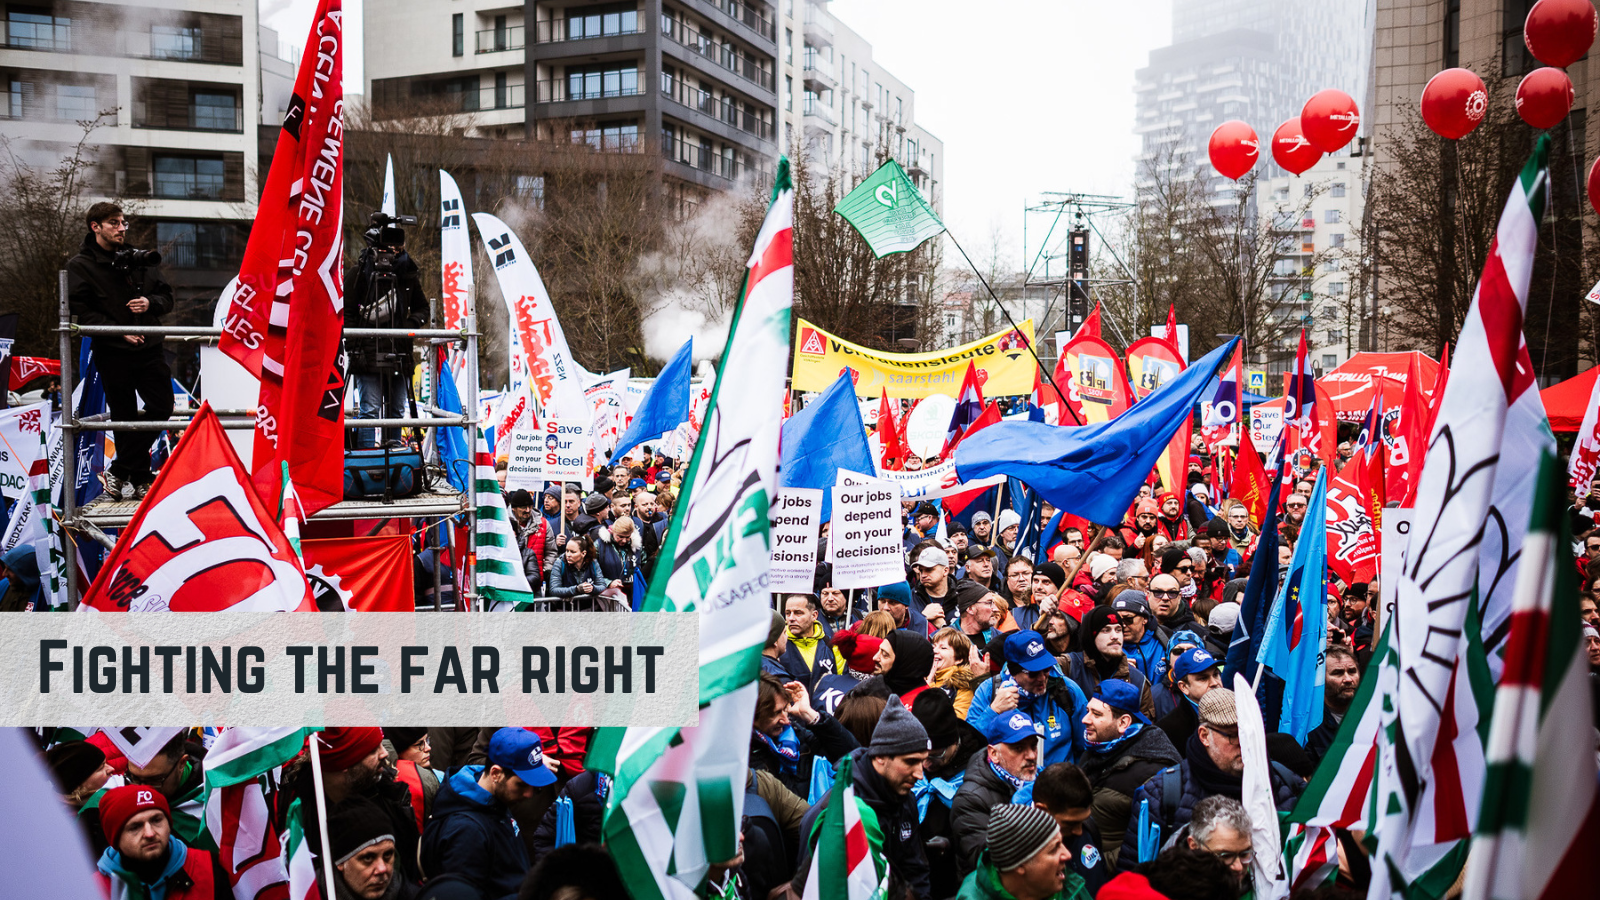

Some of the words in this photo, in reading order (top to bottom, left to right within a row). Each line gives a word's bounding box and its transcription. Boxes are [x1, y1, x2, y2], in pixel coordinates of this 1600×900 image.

[831, 339, 995, 368] Vertrauensleute
[889, 370, 955, 384] saarstahl
[1253, 410, 1279, 419] Save
[546, 421, 583, 435] Save
[1253, 419, 1272, 433] Our
[545, 434, 573, 452] Our
[1254, 432, 1279, 441] Stee
[516, 445, 542, 453] depend
[525, 456, 541, 464] your
[546, 453, 583, 466] Steel
[894, 468, 946, 480] DUMPING
[782, 495, 812, 510] jobs
[841, 493, 864, 504] Our
[866, 491, 892, 505] jobs
[775, 515, 810, 529] pend
[844, 508, 892, 524] depend
[776, 534, 808, 547] your
[845, 531, 861, 540] on
[864, 528, 893, 542] your
[836, 543, 900, 559] decisions!
[137, 791, 153, 802] FO
